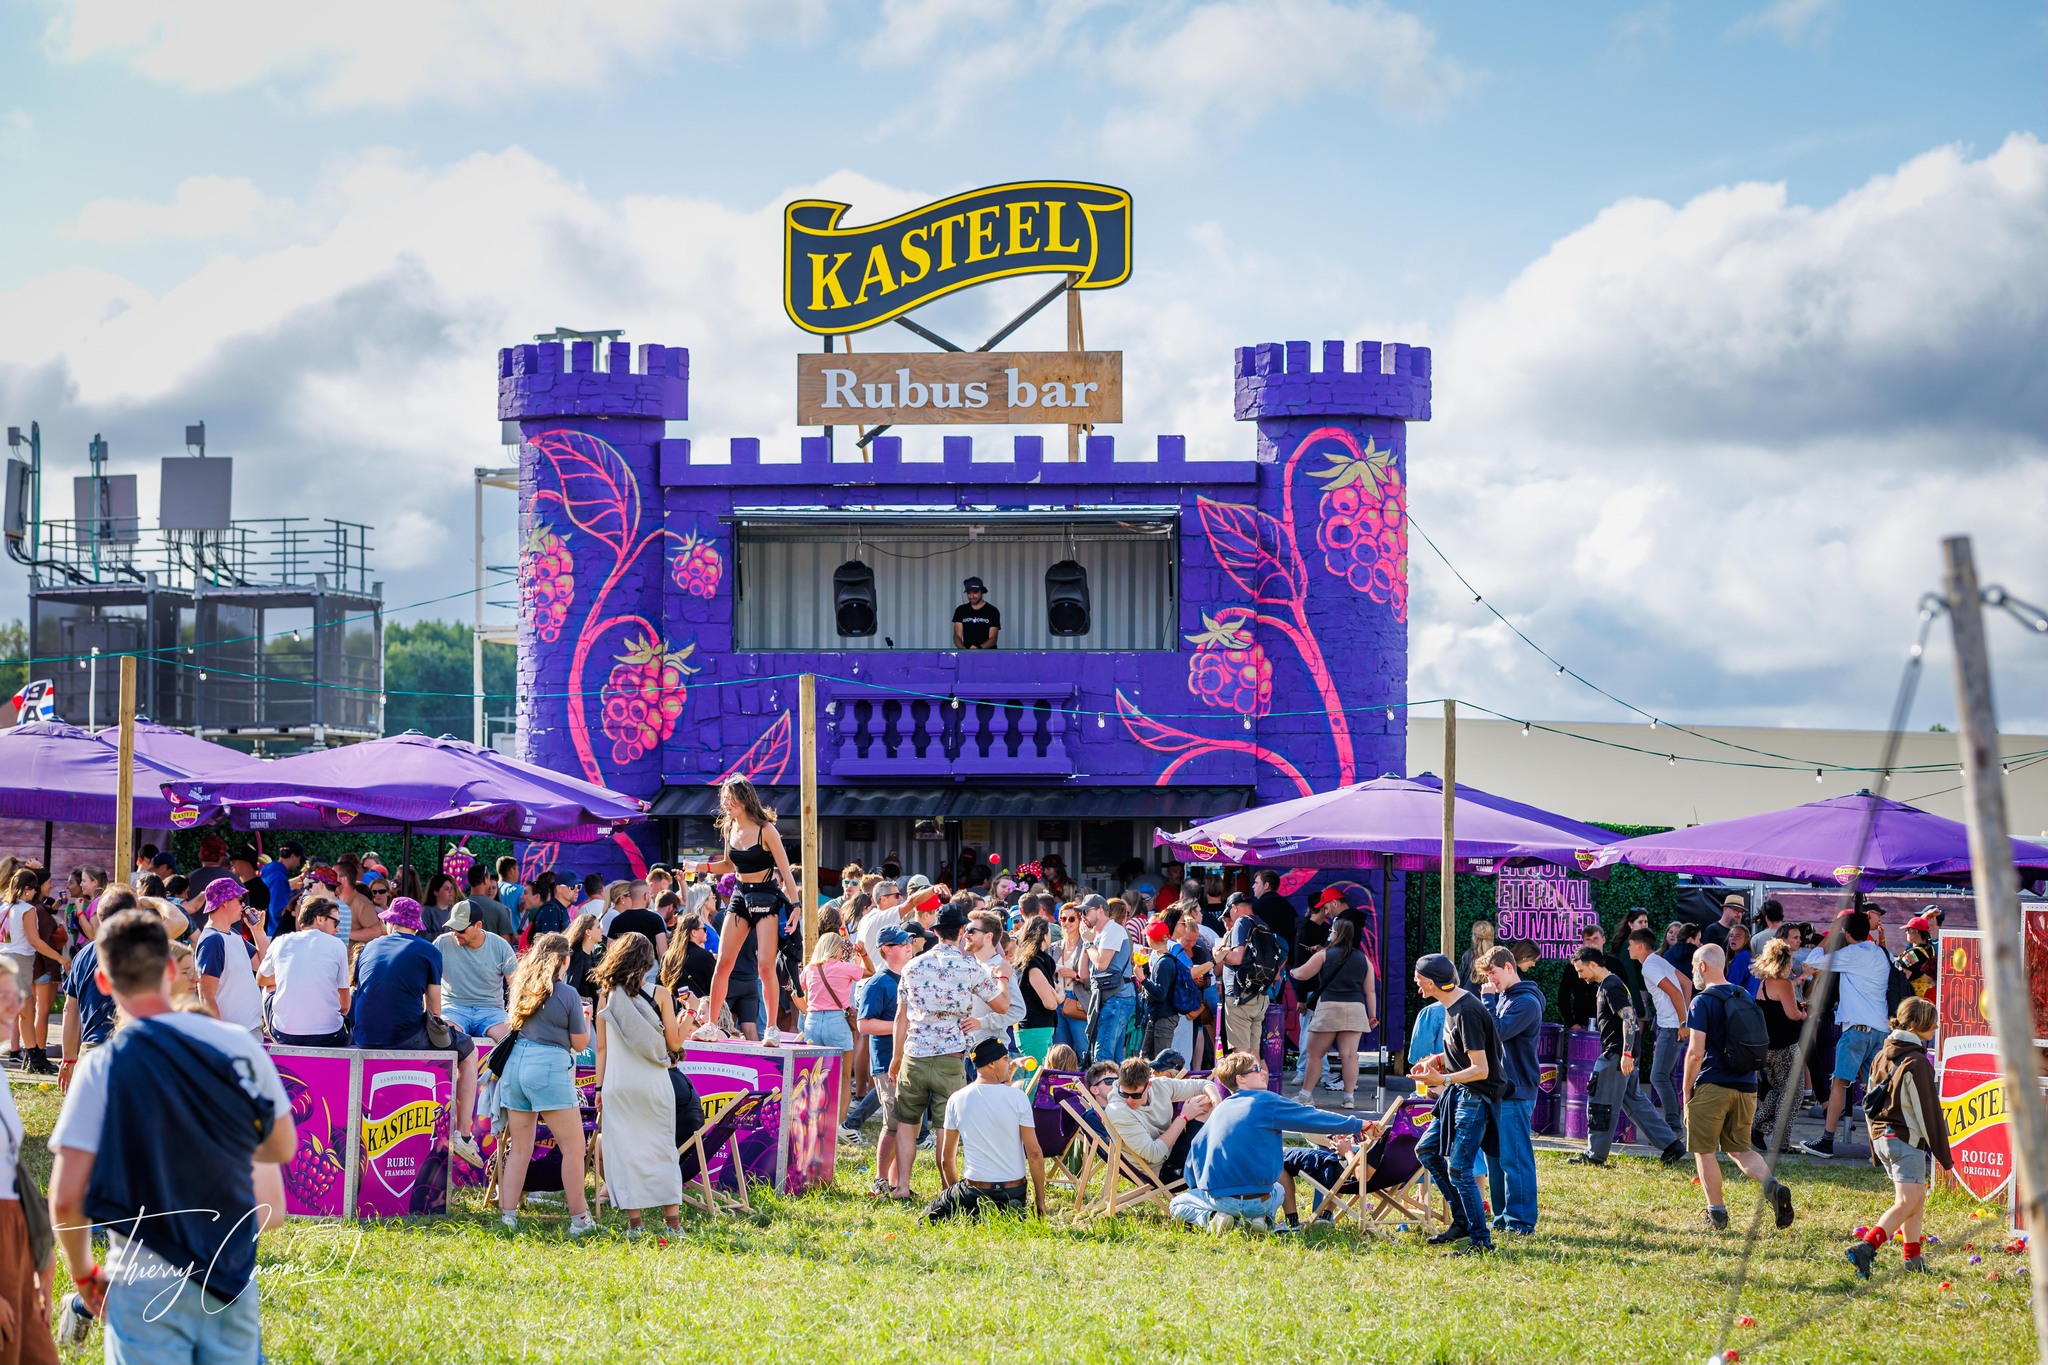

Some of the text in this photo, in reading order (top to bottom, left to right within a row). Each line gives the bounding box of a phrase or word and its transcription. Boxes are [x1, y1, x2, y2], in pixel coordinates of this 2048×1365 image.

[807, 201, 1080, 311] KASTEEL
[820, 368, 1099, 409] Rubus bar
[1497, 879, 1592, 909] ETERNAL
[1539, 943, 1557, 959] ITH
[368, 1107, 432, 1152] KASTEEL
[386, 1157, 415, 1168] RUBUS
[1961, 1149, 2004, 1166] ROUGE
[384, 1169, 416, 1177] FRAMBOISE
[1963, 1165, 2001, 1178] ORIGINAL
